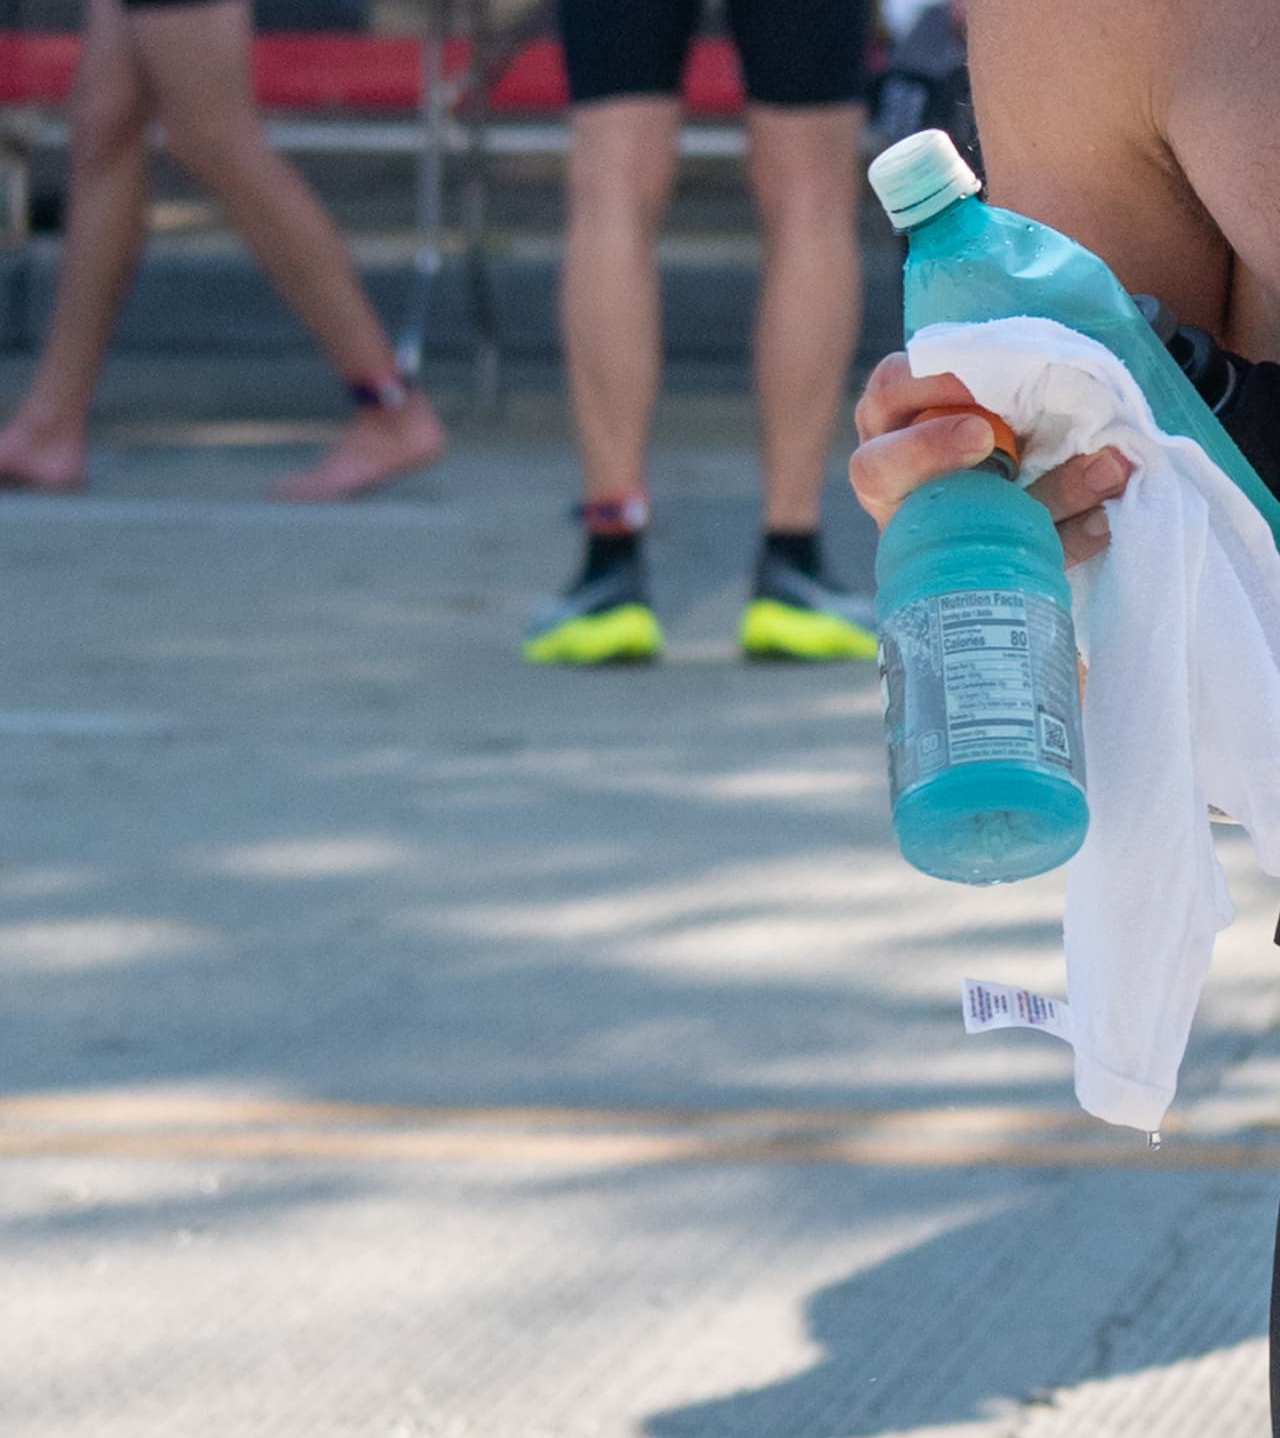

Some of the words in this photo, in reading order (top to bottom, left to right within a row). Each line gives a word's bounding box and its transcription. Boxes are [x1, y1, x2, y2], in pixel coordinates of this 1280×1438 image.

[941, 593, 991, 610] Nutrition
[993, 593, 1024, 608] Facts
[943, 635, 986, 650] Calories
[1010, 630, 1027, 647] 80
